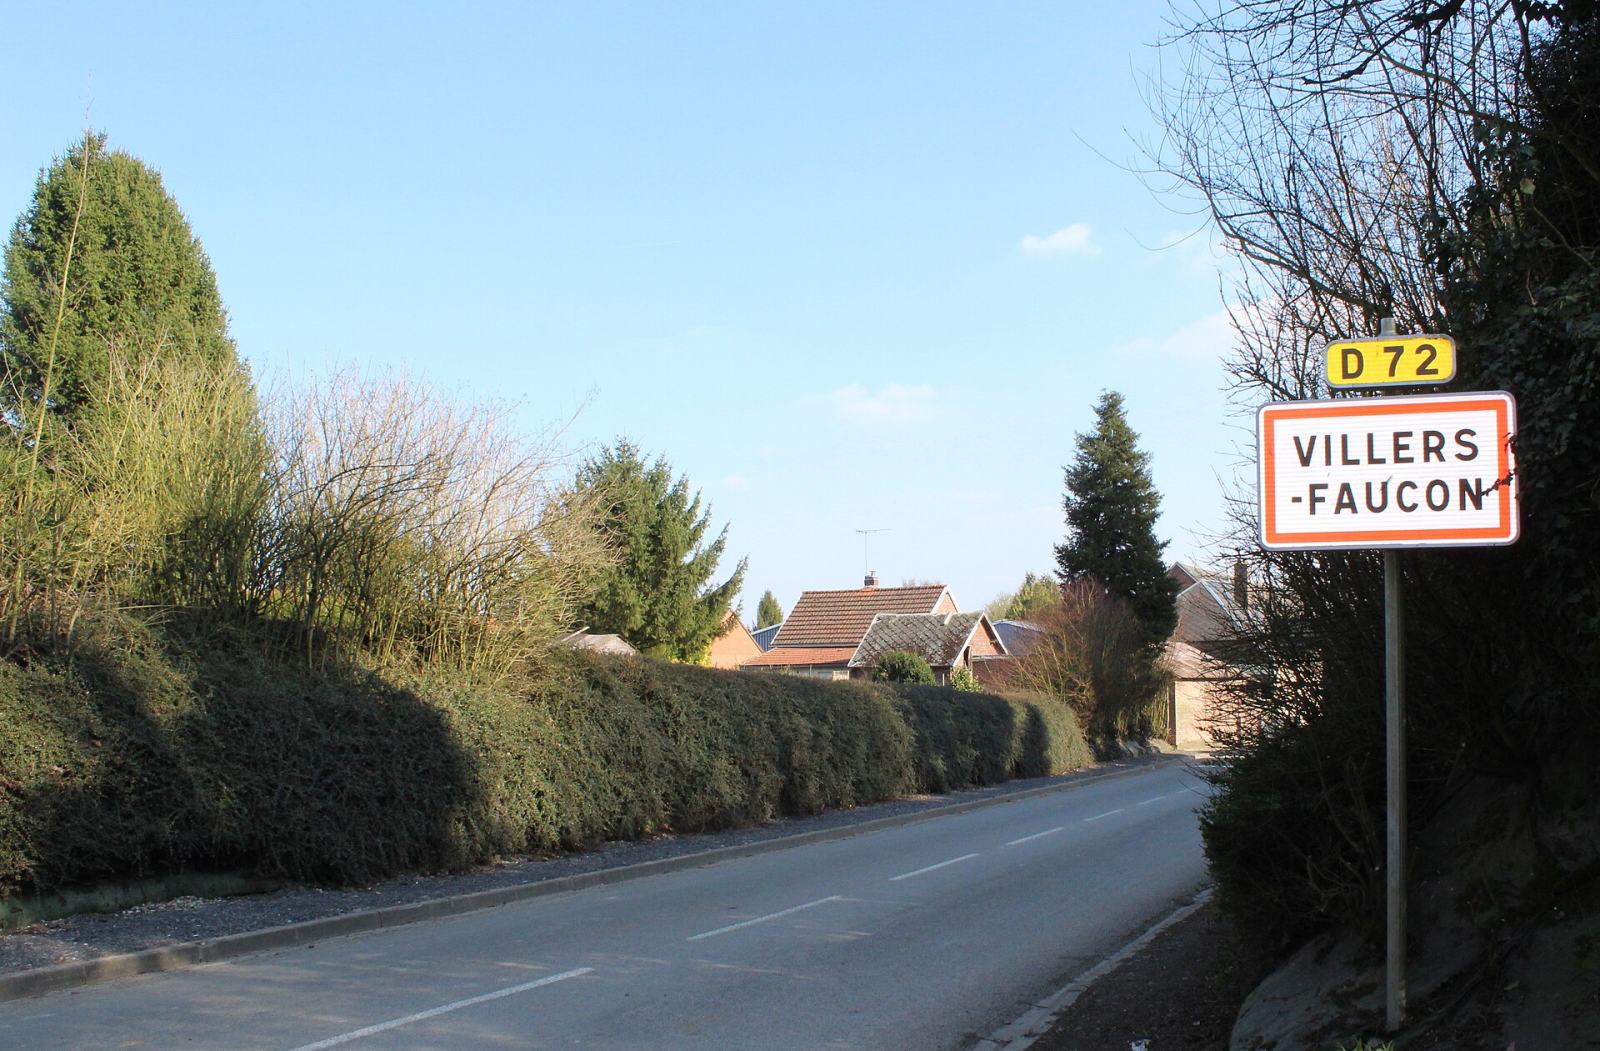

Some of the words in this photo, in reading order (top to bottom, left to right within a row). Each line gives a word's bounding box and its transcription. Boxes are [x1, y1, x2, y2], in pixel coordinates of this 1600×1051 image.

[1341, 348, 1364, 379] D
[1383, 344, 1439, 377] 72
[1293, 428, 1479, 467] VILLERS
[1291, 478, 1483, 515] -FAUCON
